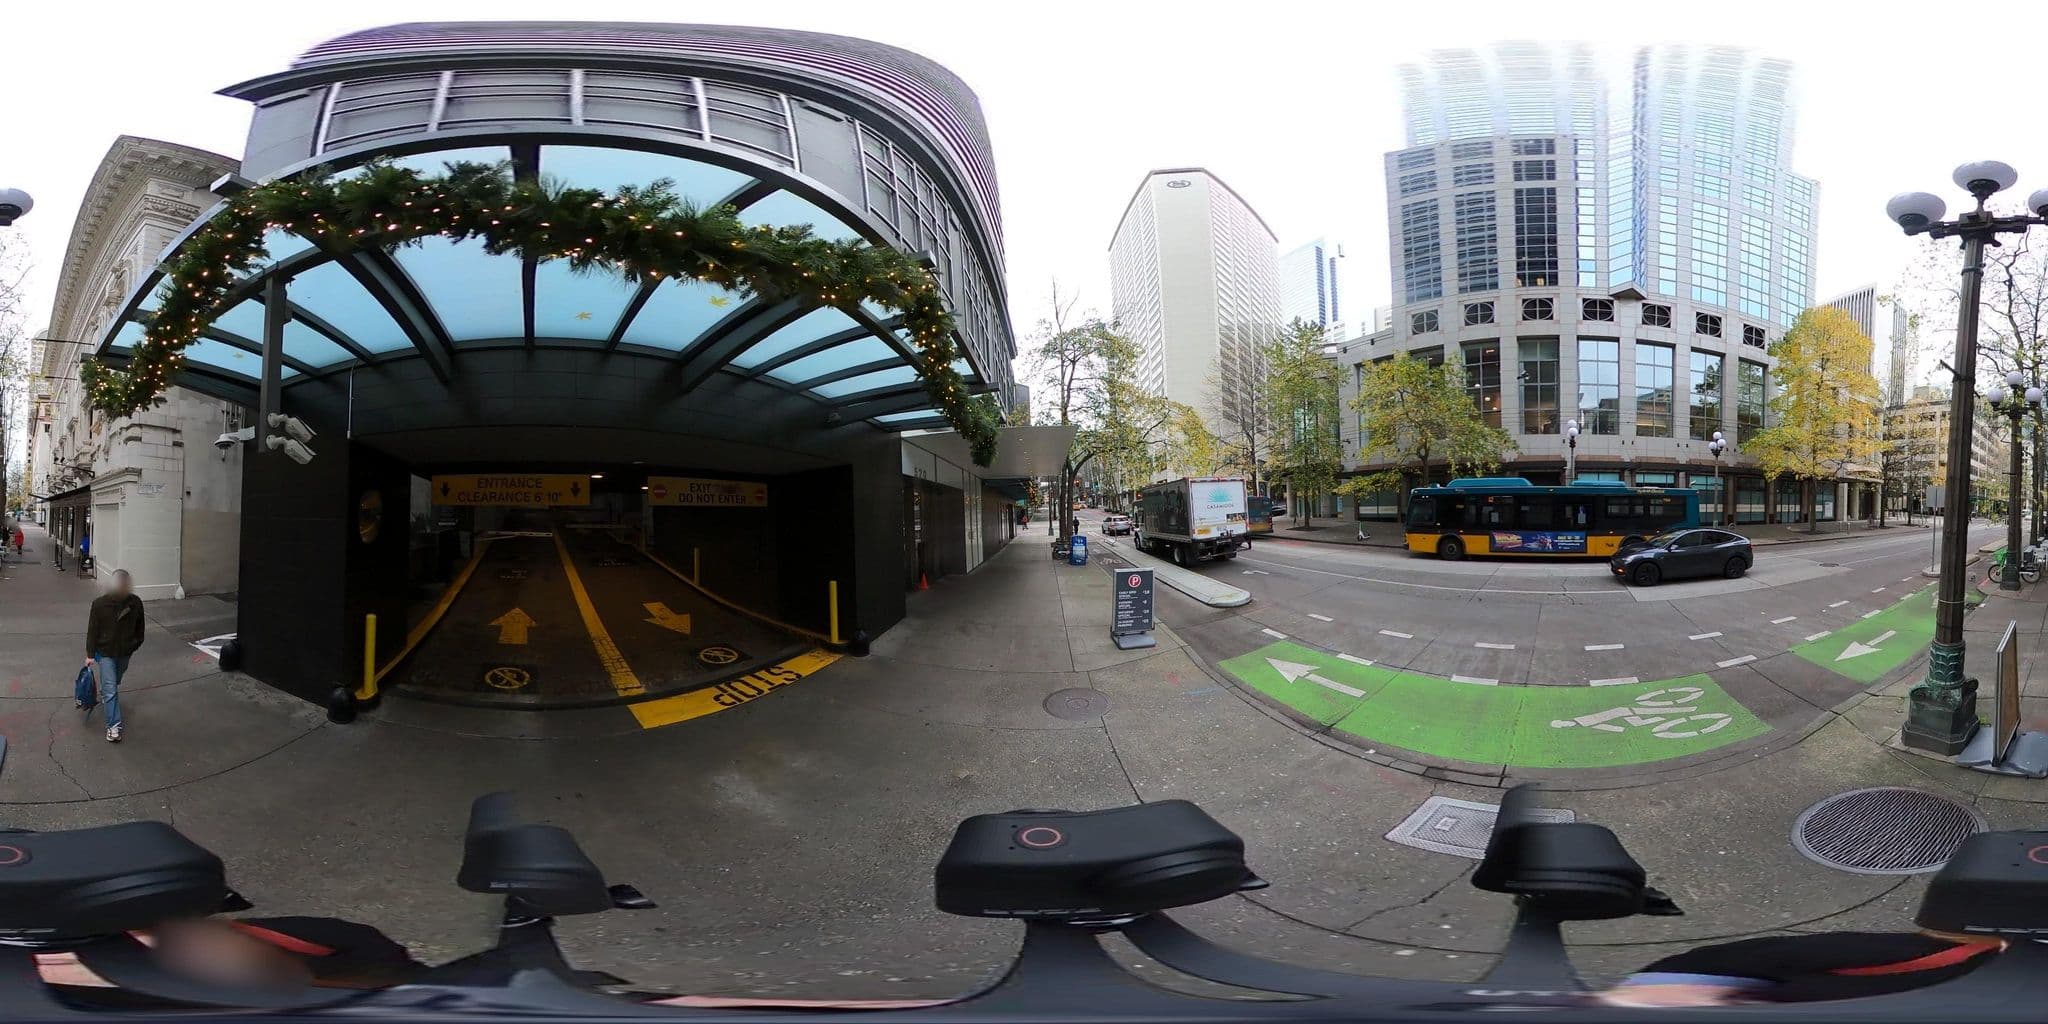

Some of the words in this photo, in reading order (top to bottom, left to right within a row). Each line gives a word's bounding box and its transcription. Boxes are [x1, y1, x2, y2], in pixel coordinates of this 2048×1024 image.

[477, 478, 543, 489] ENTRANCE
[689, 482, 713, 493] EXIT
[457, 491, 530, 503] CLEARANCE
[678, 493, 693, 503] DO
[696, 493, 715, 504] NOT
[718, 495, 746, 504] ENTER
[712, 666, 802, 706] STOP
